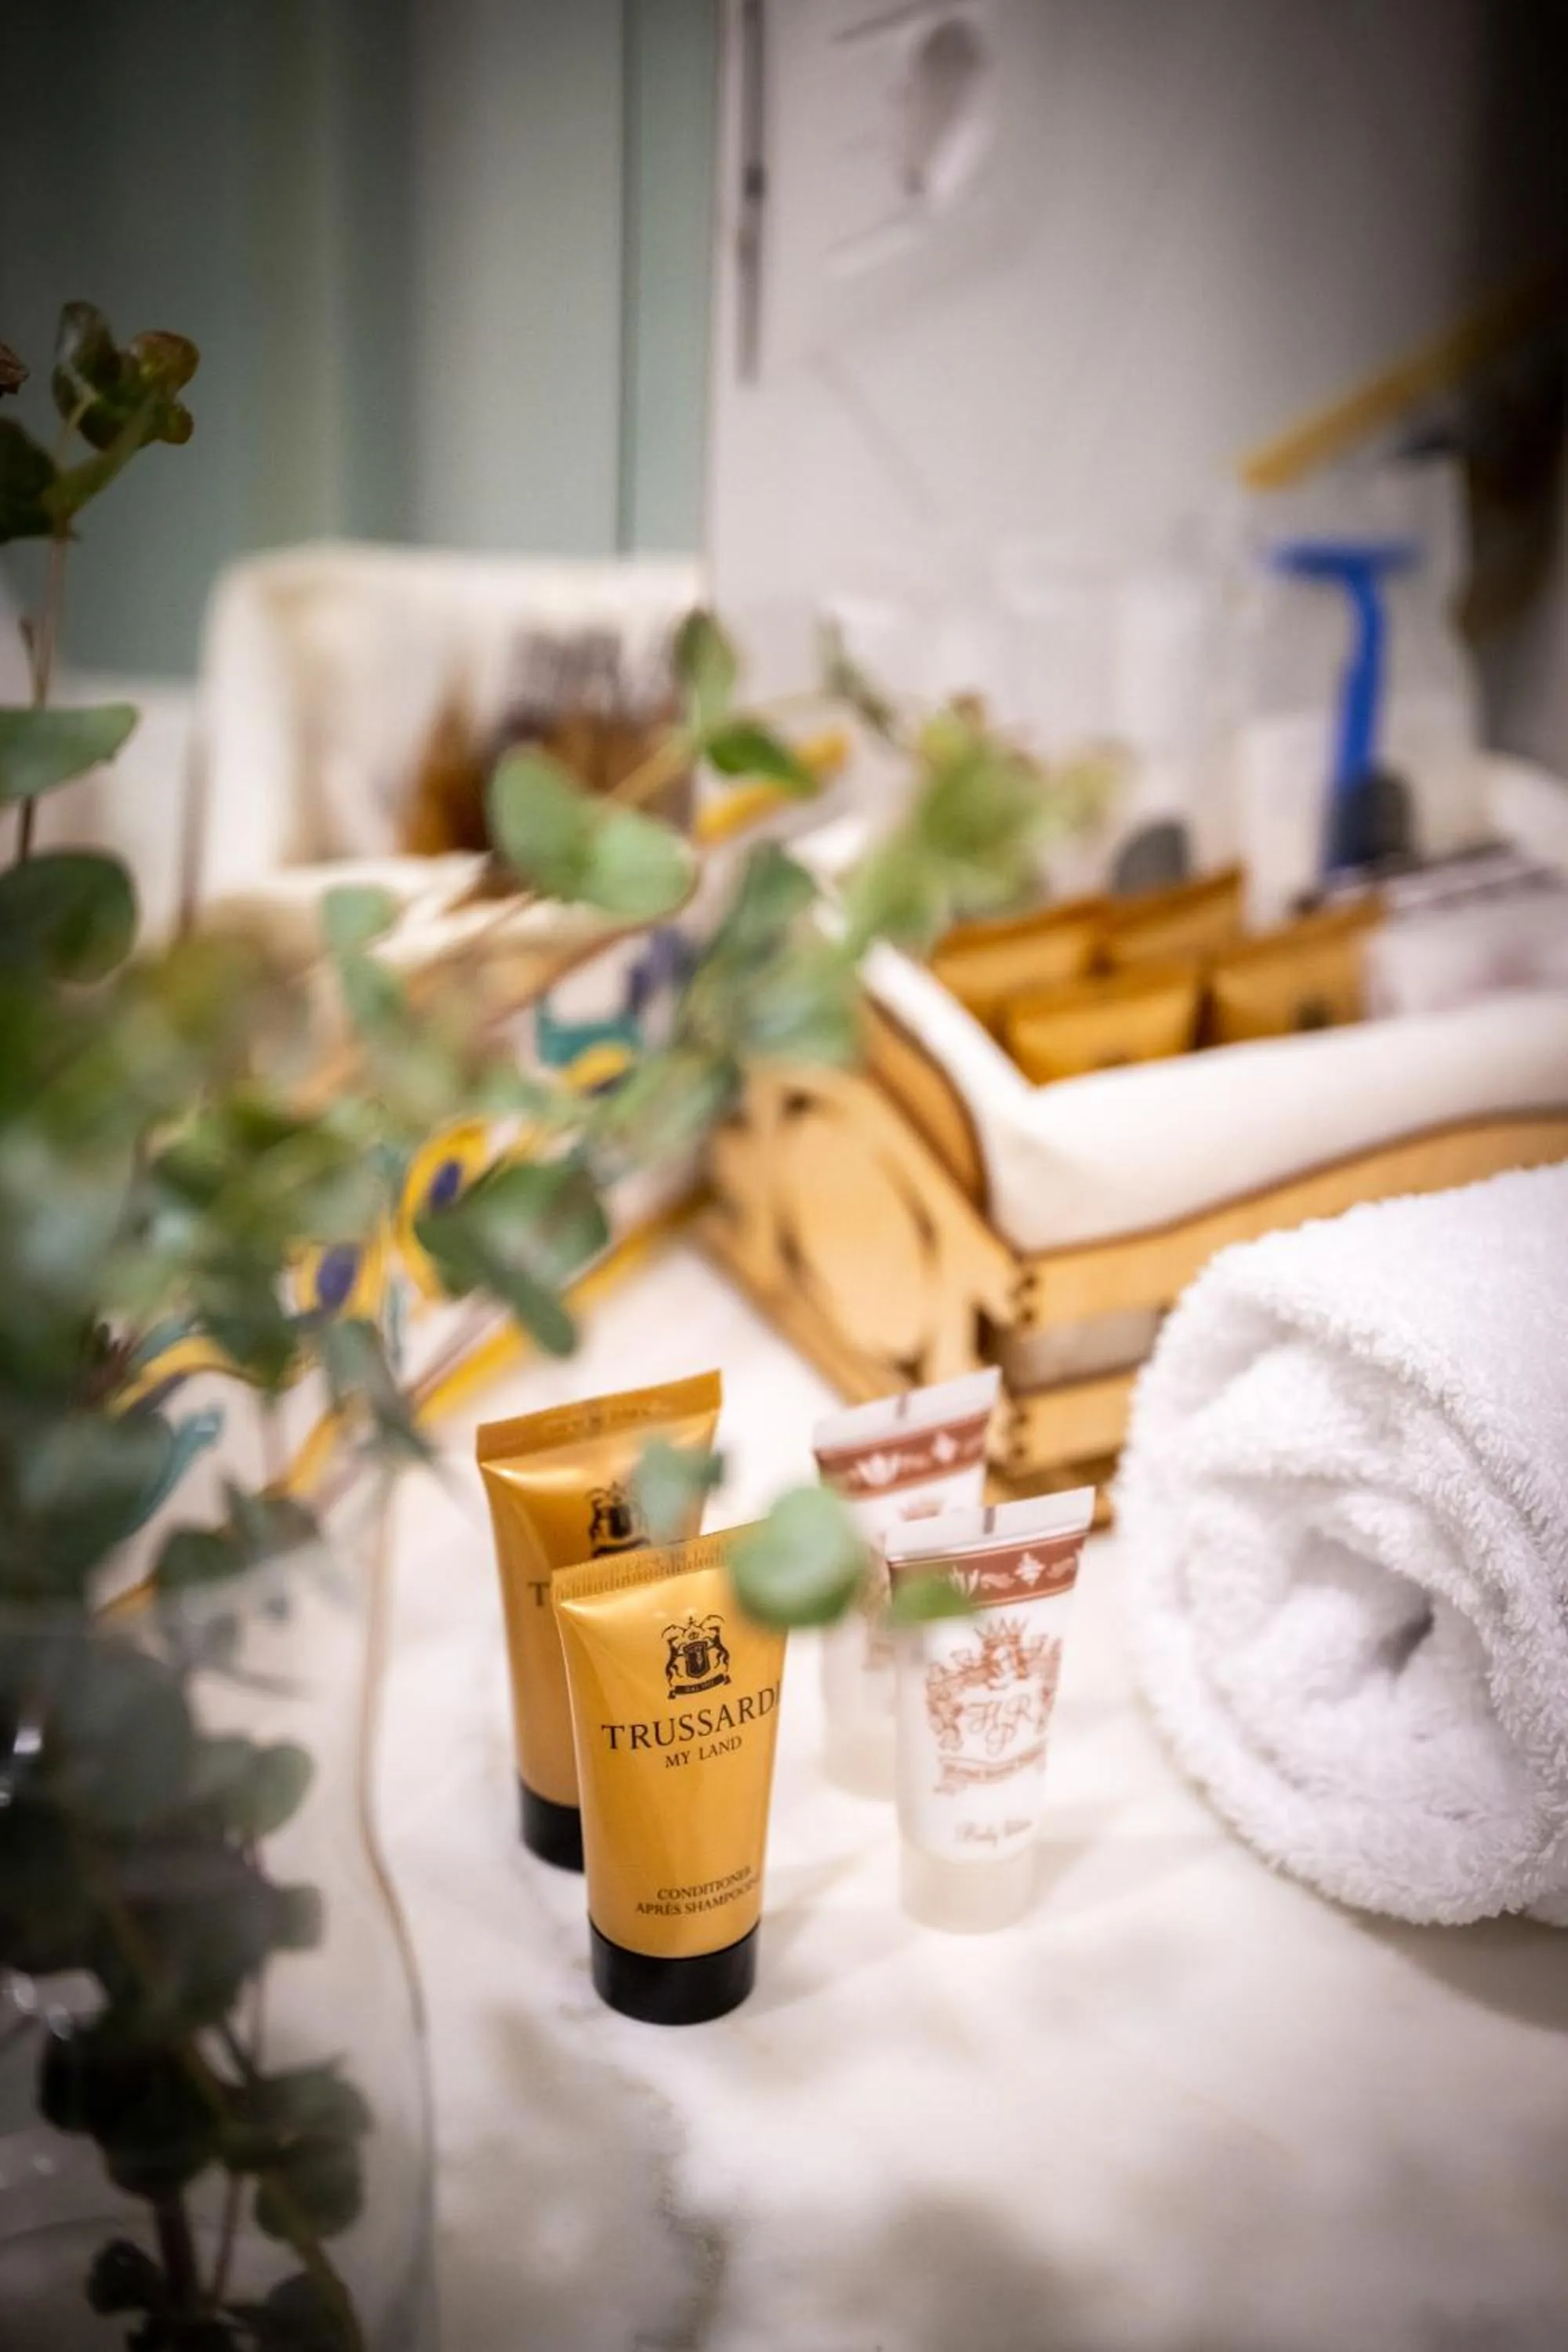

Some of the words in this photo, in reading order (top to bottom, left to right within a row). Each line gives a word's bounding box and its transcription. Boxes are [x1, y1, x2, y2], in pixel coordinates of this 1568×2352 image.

[665, 1751, 691, 1768] MY
[699, 1735, 742, 1761] LAND
[657, 1866, 751, 1900] CONDITIONER
